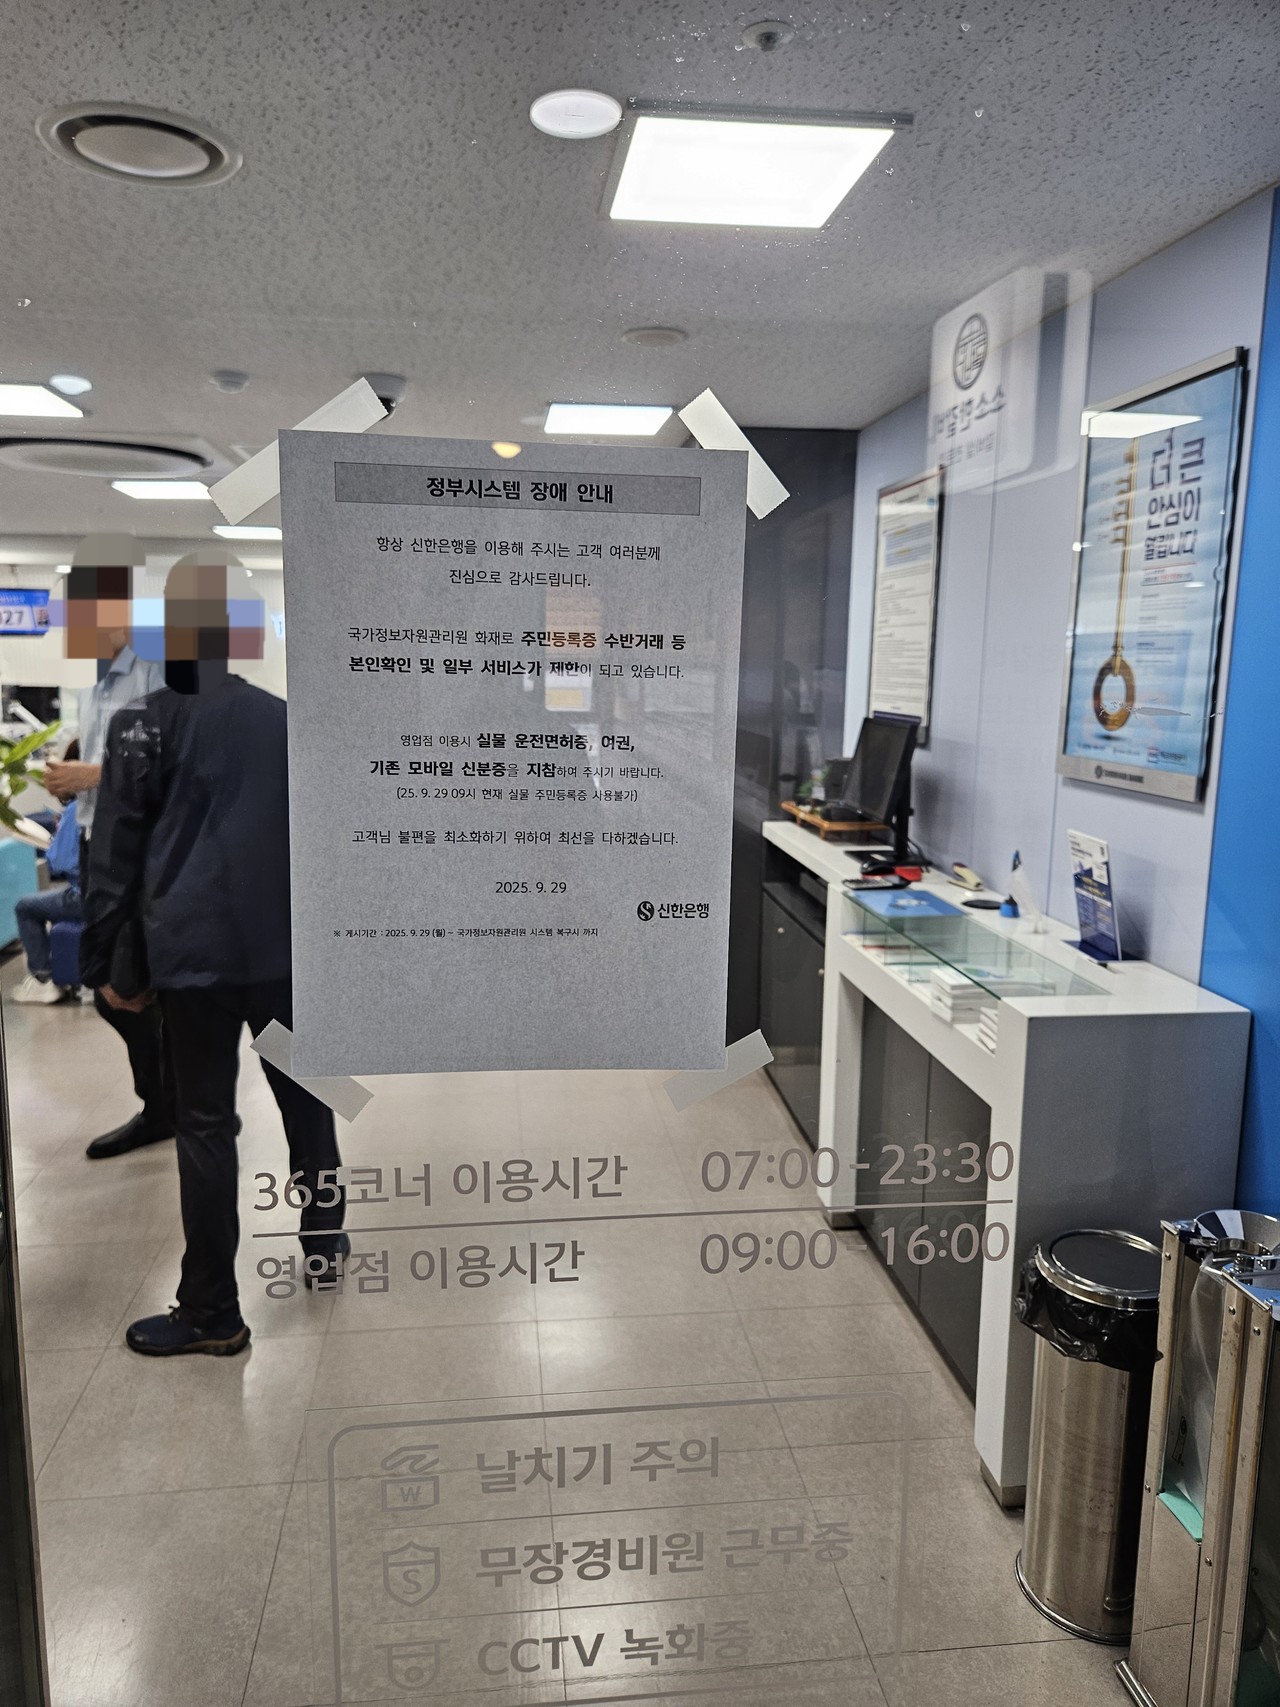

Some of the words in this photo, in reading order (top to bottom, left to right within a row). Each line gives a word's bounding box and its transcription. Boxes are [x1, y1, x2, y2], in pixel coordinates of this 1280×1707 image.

[1179, 437, 1206, 486] 큰
[426, 477, 521, 501] 정부시스템
[529, 481, 568, 503] 장애
[577, 483, 613, 504] 안내
[1147, 487, 1202, 530] 안심이
[376, 536, 404, 553] 항상
[410, 537, 478, 555] 신한은행을
[484, 540, 524, 557] 이용해
[530, 542, 571, 558] 주시는
[576, 544, 602, 560] 고객
[609, 545, 661, 561] 여러분께
[448, 569, 503, 585] 진심으로
[508, 571, 591, 589] 감사드립니다.
[0, 610, 24, 626] 27
[347, 627, 468, 645] 국가정보자원관리원
[474, 630, 515, 646] 화재로
[520, 631, 598, 649] 주민등록증
[602, 632, 664, 650] 수반거래
[670, 634, 687, 651] 등
[348, 656, 412, 674] 본인확인
[419, 657, 435, 674] 및
[442, 658, 474, 675] 일부
[480, 659, 543, 677] 서비스가
[549, 660, 592, 677] 제한이
[598, 663, 625, 678] 되고
[630, 664, 684, 680] 있습니다.
[400, 734, 433, 747] 영업점
[438, 735, 471, 748] 이용시
[476, 732, 507, 749] 실물
[513, 733, 593, 752] 운전면허증,
[600, 734, 635, 752] 여권,
[369, 760, 401, 776] 기존
[407, 760, 454, 777] 모바일
[460, 761, 520, 778] 신분증을
[526, 762, 578, 778] 지참하여
[582, 766, 614, 779] 주시기
[619, 766, 664, 779] 바랍니다.
[481, 788, 503, 800] 현재
[508, 788, 530, 801] 실물
[534, 789, 588, 802] 주민등록증
[591, 789, 638, 802] 사용불가)
[351, 829, 391, 844] 고객님
[397, 830, 438, 845] 불편을
[443, 830, 507, 845] 최소화하기
[513, 830, 551, 845] 위하여
[557, 831, 596, 846] 최선을
[601, 831, 679, 846] 다하겠습니다.
[656, 902, 710, 919] 신한은행
[344, 928, 378, 938] 게시기간
[456, 927, 527, 938] 국가정보자원관리원
[529, 927, 553, 938] 시스템
[556, 928, 580, 937] 복구시
[582, 927, 599, 937] 까지
[252, 1162, 432, 1212] 365코너
[452, 1154, 629, 1204] 이용시간
[701, 1146, 840, 1193] 07:00
[879, 1140, 1015, 1186] 23:30
[256, 1249, 390, 1299] 영업점
[409, 1240, 586, 1290] 이용시간
[700, 1228, 838, 1274] 09:00
[880, 1221, 1011, 1266] 16:00
[475, 1443, 612, 1494] 날치기
[630, 1436, 721, 1482] 주의
[475, 1531, 705, 1588] 무장경비원
[720, 1521, 855, 1568] 근무중
[477, 1632, 606, 1677] CCTV
[619, 1618, 752, 1666] 녹화중
